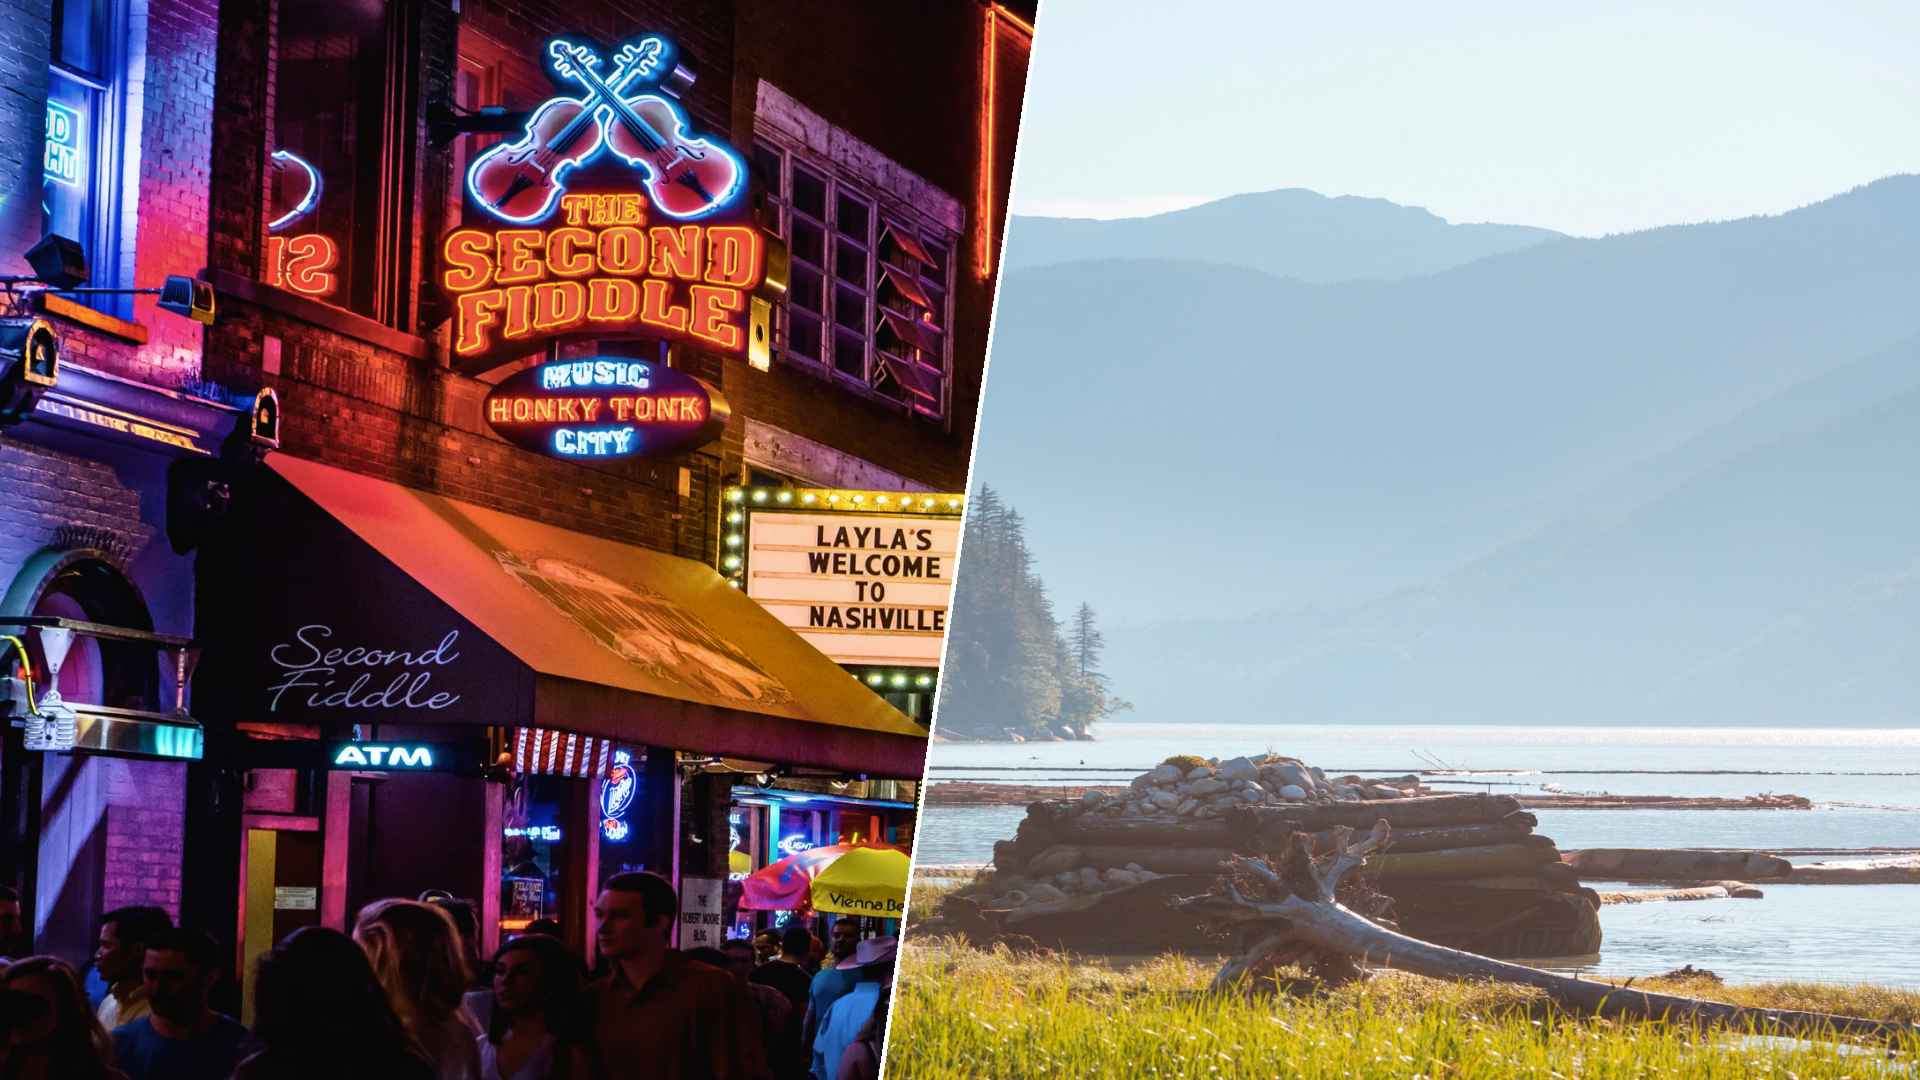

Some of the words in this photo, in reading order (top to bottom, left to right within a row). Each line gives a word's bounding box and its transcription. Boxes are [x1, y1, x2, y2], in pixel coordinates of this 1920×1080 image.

[560, 194, 646, 225] THE
[444, 226, 761, 292] SECOND
[456, 278, 742, 353] FIDDLE
[543, 360, 650, 389] MUSIC
[490, 397, 600, 422] HONKY
[609, 396, 705, 423] TONK
[554, 427, 635, 455] CITY
[816, 525, 932, 551] LAYLA'S
[808, 552, 941, 578] WELCOME
[855, 581, 885, 602] TO
[809, 606, 945, 631] NASHVILLE
[270, 624, 460, 669] Second
[267, 667, 460, 712] Fiddle
[335, 746, 433, 766] ATM
[830, 893, 883, 911] Vienna
